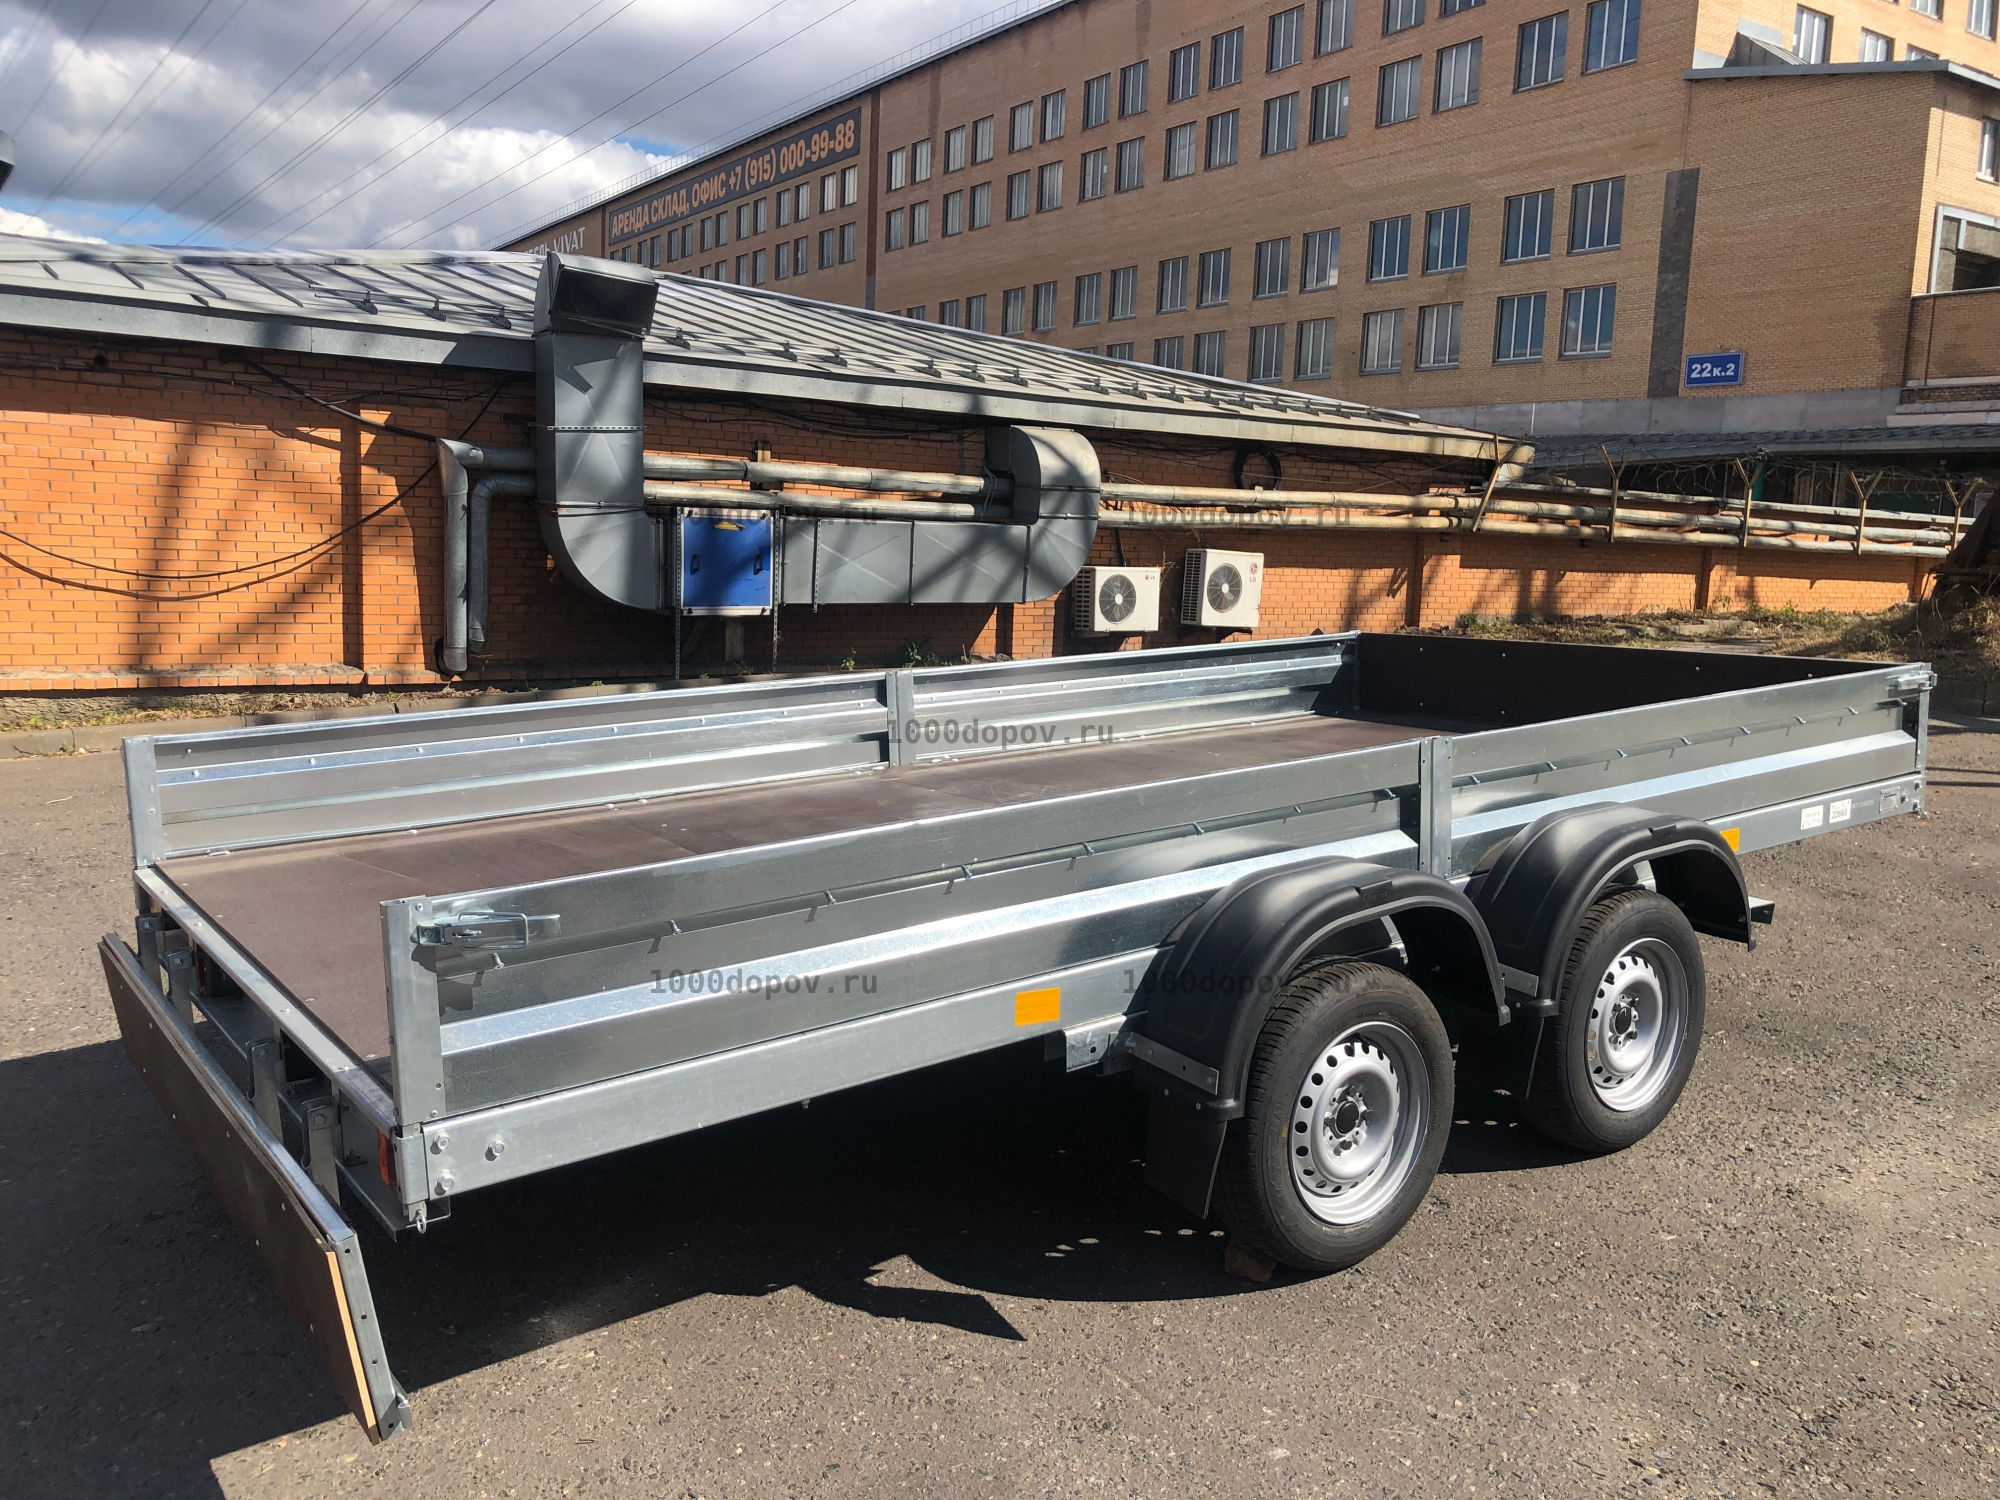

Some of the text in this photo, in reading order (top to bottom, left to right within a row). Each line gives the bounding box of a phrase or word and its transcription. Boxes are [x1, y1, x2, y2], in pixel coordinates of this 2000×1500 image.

[611, 119, 855, 238] АРЕНДА СКЛАД, ОФИС +7 (915) 000-99-88
[553, 227, 586, 254] VIVAT
